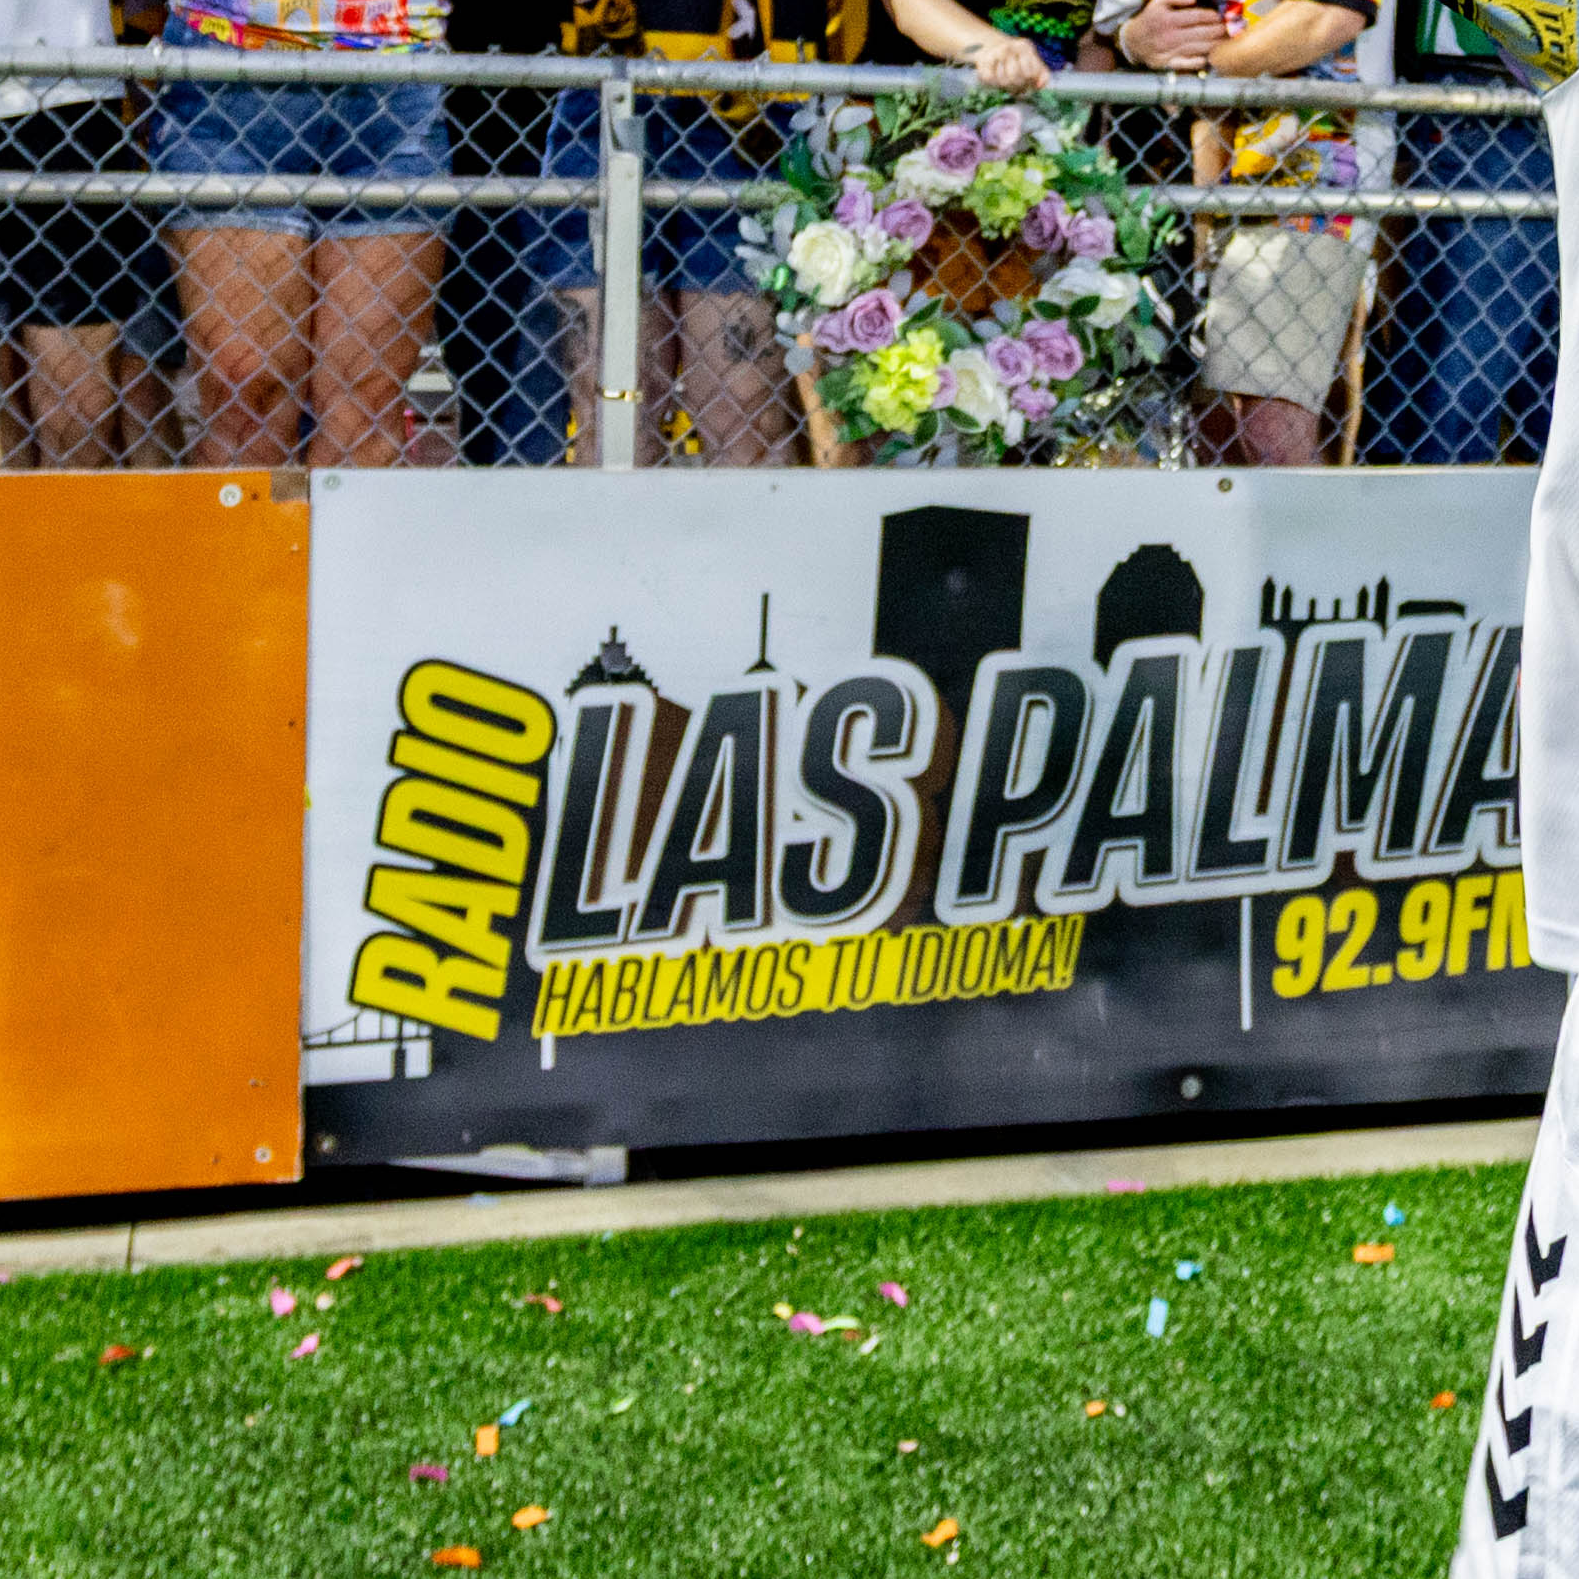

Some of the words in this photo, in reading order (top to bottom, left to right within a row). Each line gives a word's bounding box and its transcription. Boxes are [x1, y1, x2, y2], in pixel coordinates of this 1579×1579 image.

[348, 659, 556, 1042] RADIO
[539, 675, 918, 947] LAS
[538, 940, 813, 1035] HABLAMOS
[829, 932, 886, 1010] TU
[896, 915, 1084, 1003] IDIOMA!
